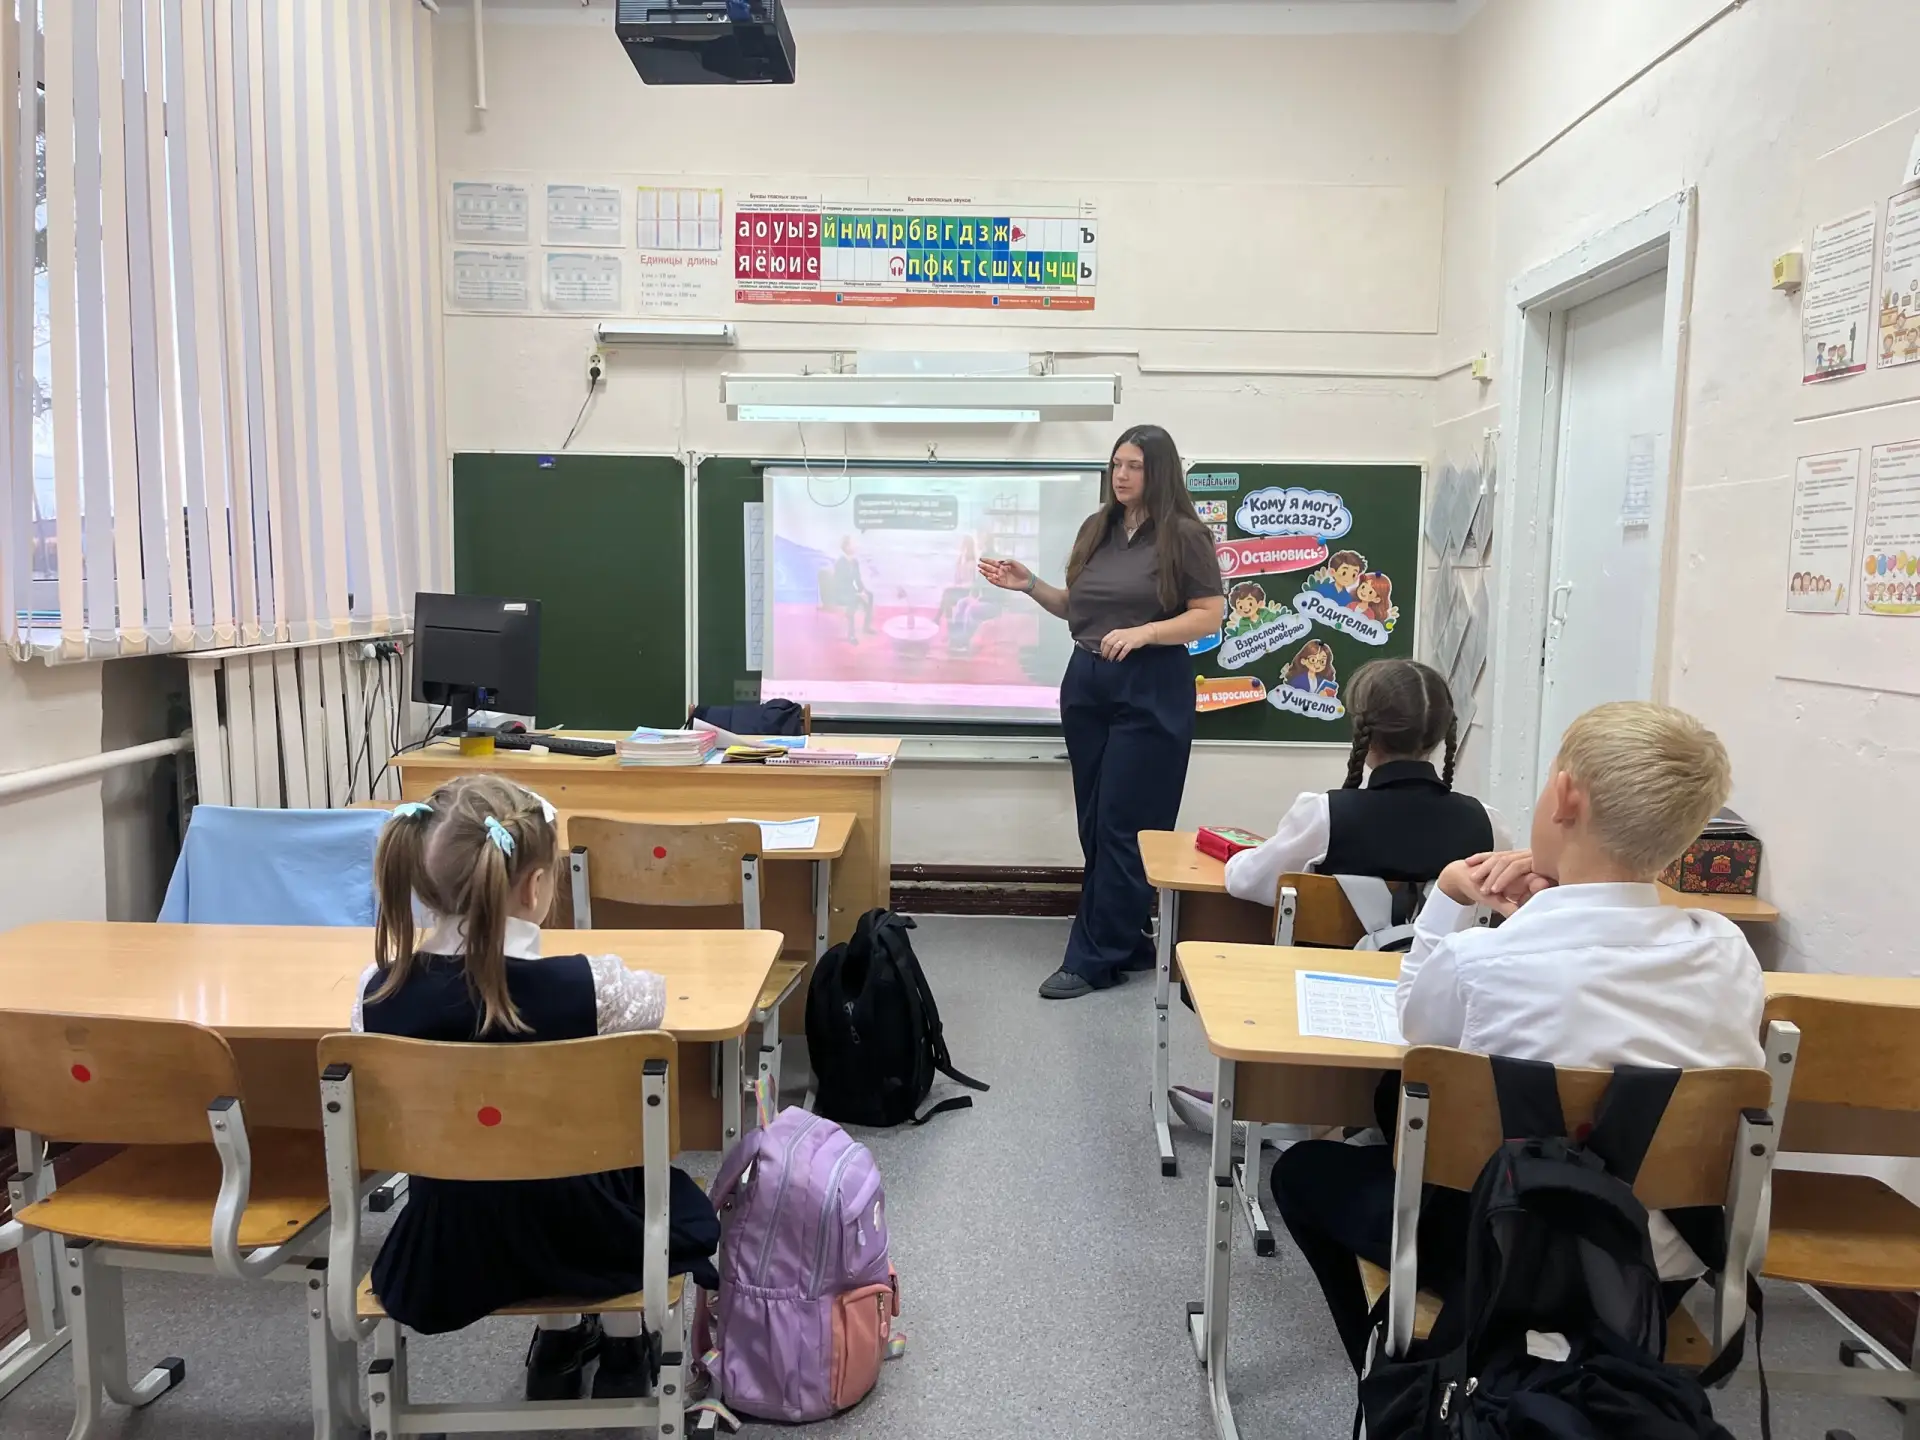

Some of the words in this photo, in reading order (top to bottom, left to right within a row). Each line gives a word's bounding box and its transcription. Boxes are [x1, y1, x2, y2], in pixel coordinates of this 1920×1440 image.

[640, 255, 683, 267] Единицы
[687, 257, 718, 267] длины
[1189, 477, 1237, 487] ПОНЕДЕЛЬНИК
[1249, 497, 1287, 513] Кому
[1289, 497, 1299, 509] Я
[1302, 499, 1339, 518] могу
[1250, 513, 1343, 531] рассказать?
[1241, 549, 1318, 565] Остановись
[1307, 597, 1379, 639] Родителям
[1227, 641, 1267, 665] которому
[1268, 623, 1305, 647] доверяю
[1234, 621, 1289, 651] Взрослому,
[1212, 691, 1260, 704] взрослого
[1281, 690, 1336, 715] Учителю
